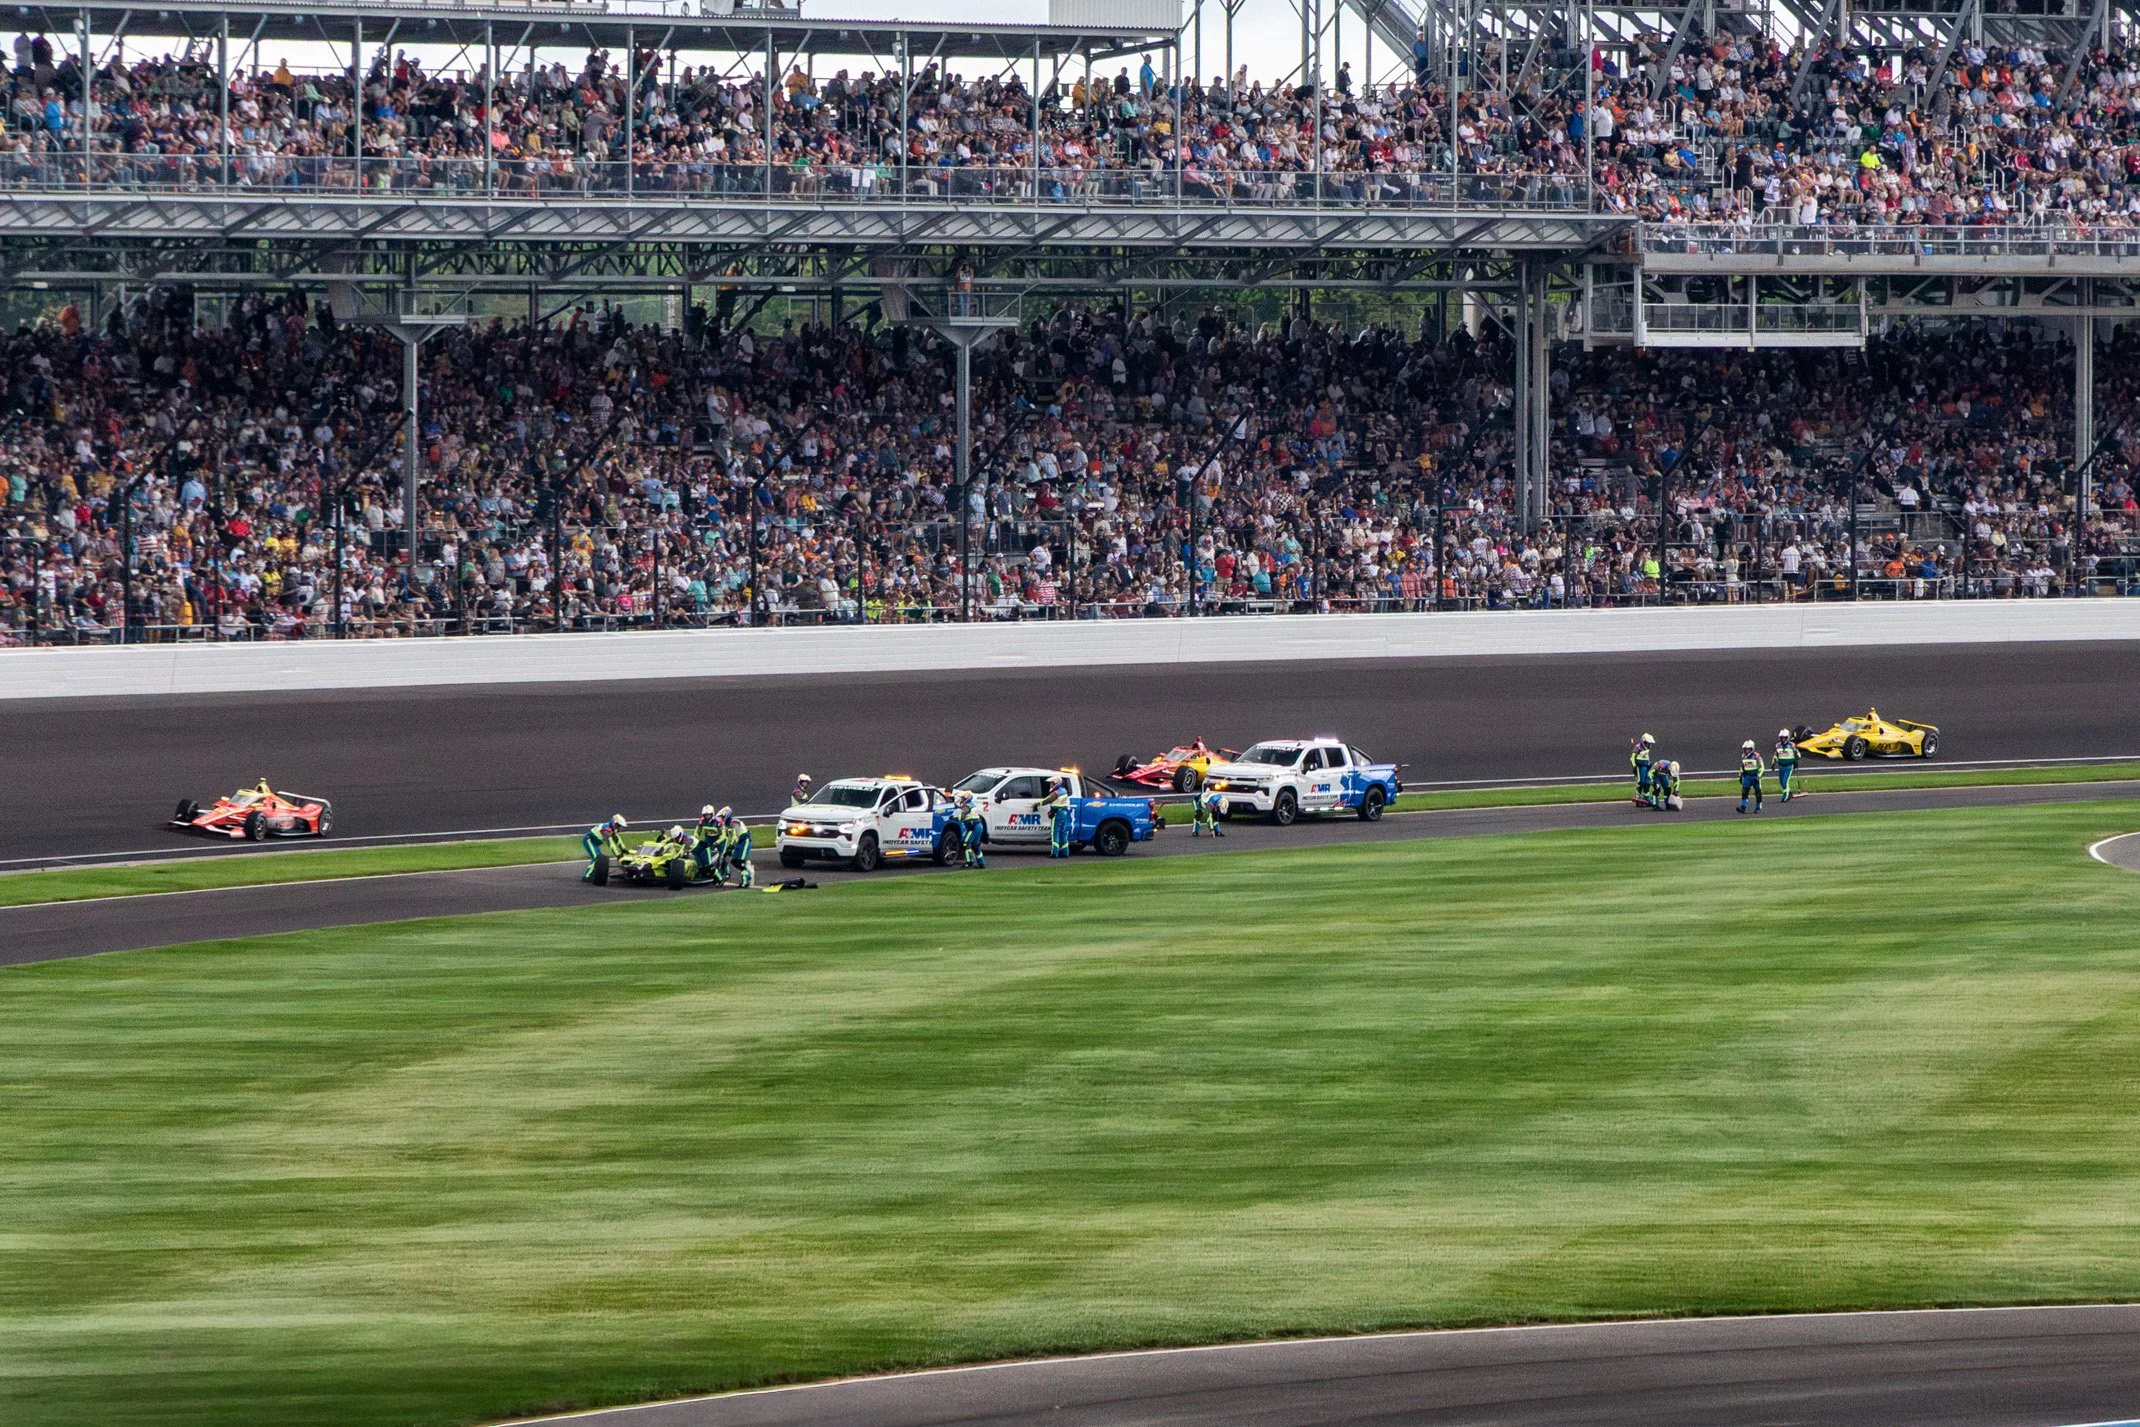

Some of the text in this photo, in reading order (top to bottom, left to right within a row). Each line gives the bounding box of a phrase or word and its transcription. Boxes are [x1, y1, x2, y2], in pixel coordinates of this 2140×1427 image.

[1311, 783, 1331, 793] AMR
[982, 801, 989, 812] 2
[1008, 813, 1041, 825] AMR
